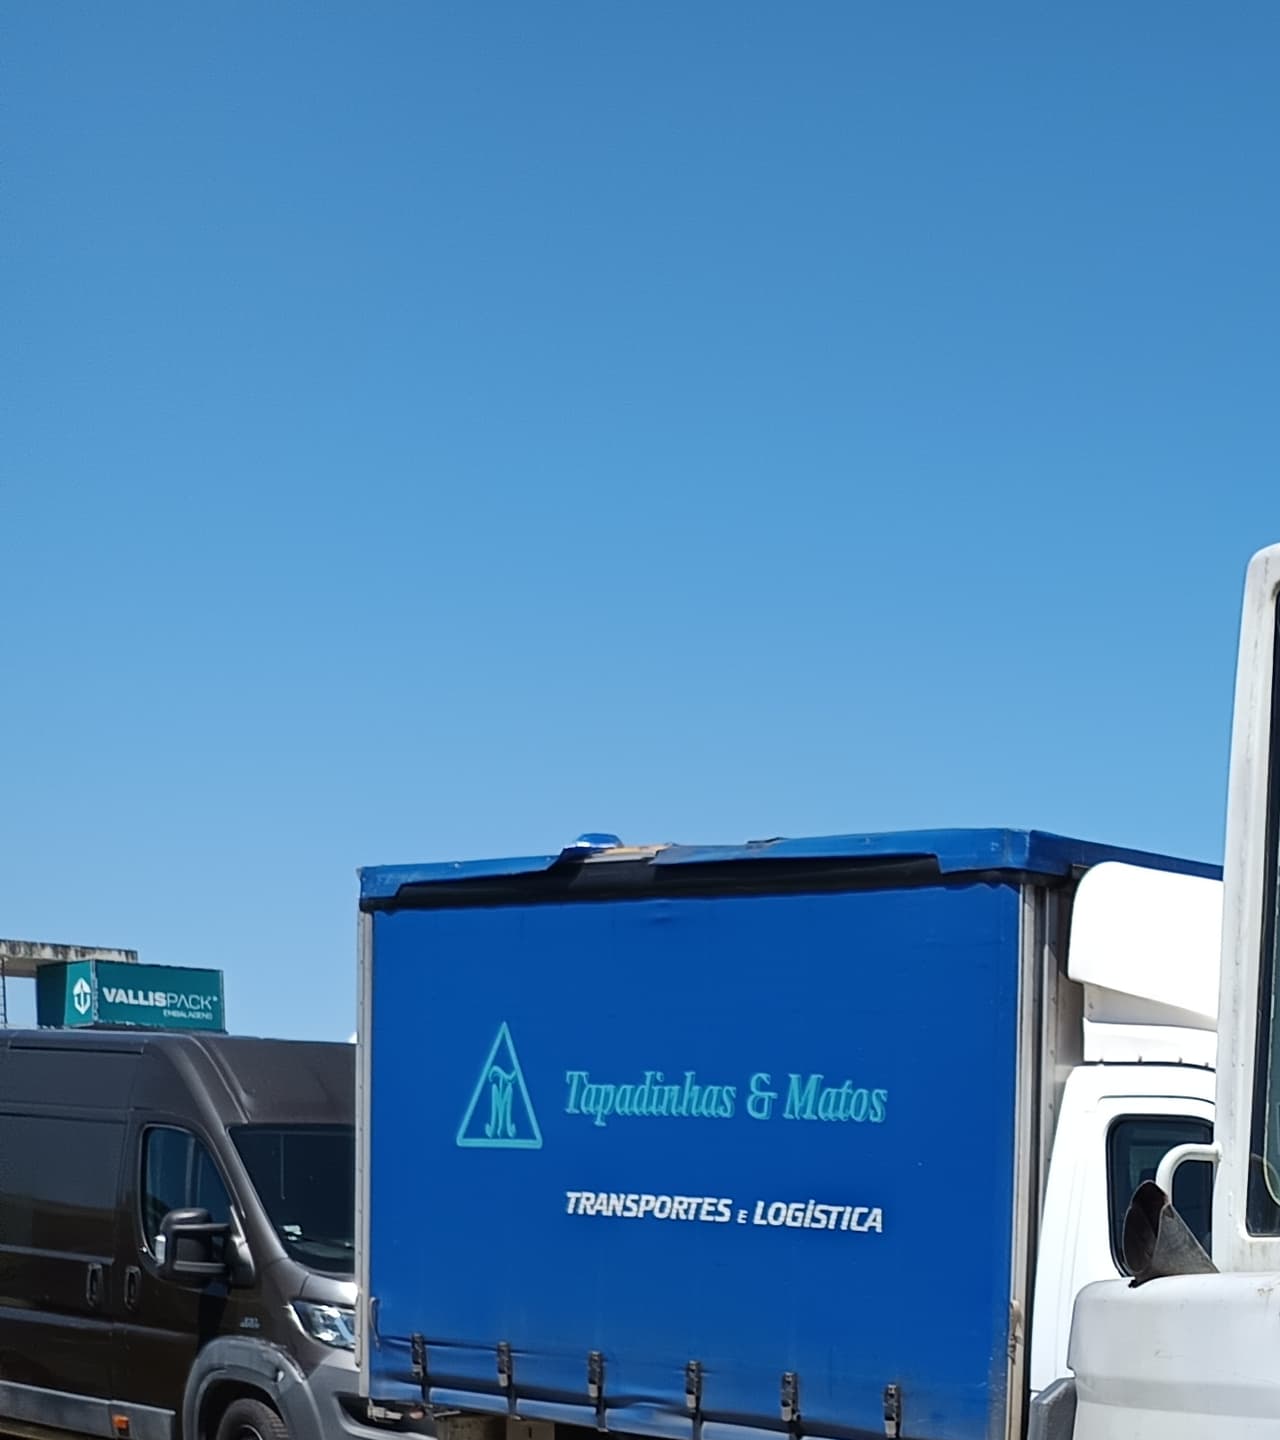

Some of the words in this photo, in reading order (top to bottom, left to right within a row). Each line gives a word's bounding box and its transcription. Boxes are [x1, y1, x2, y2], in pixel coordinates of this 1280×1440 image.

[566, 1070, 737, 1126] Tapadinhas
[746, 1072, 778, 1120] &
[783, 1074, 888, 1122] Matos
[566, 1191, 733, 1222] TRANSPORTES
[753, 1199, 883, 1233] LOGÍSTICA
